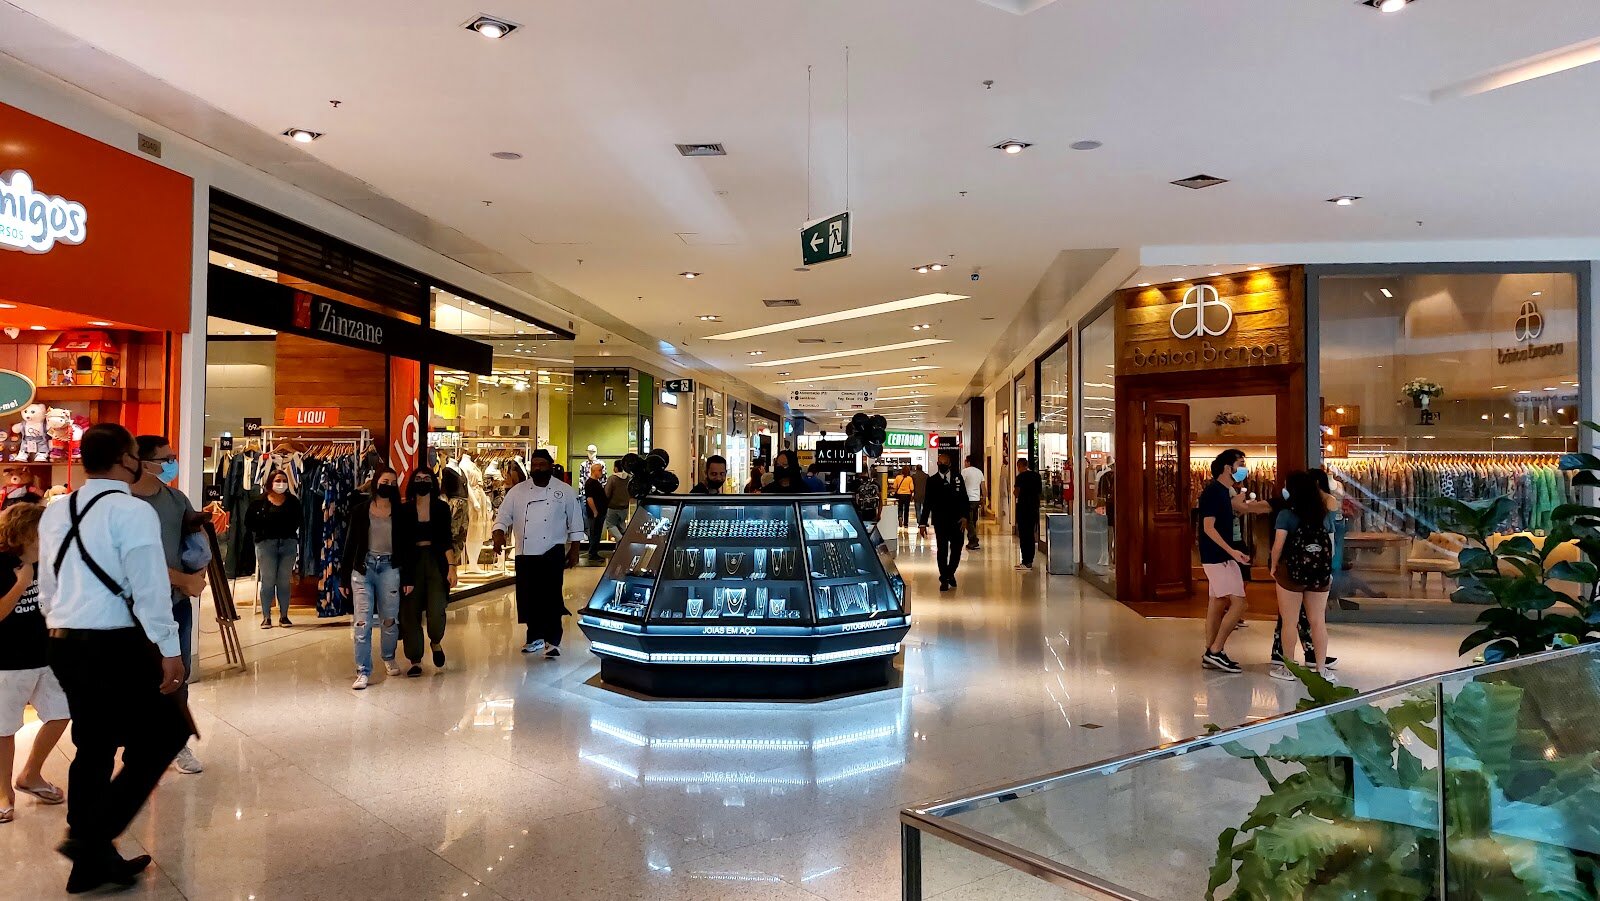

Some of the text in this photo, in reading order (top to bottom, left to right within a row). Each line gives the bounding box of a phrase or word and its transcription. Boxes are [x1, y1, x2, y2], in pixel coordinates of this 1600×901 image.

[319, 302, 383, 345] Zinzane
[297, 410, 326, 424] LIQUI
[887, 433, 924, 447] CENTAURO
[14, 605, 36, 614] Que
[702, 626, 757, 636] JOIAS EM AÇO
[842, 618, 888, 632] FOTOGRAVAÇÃO
